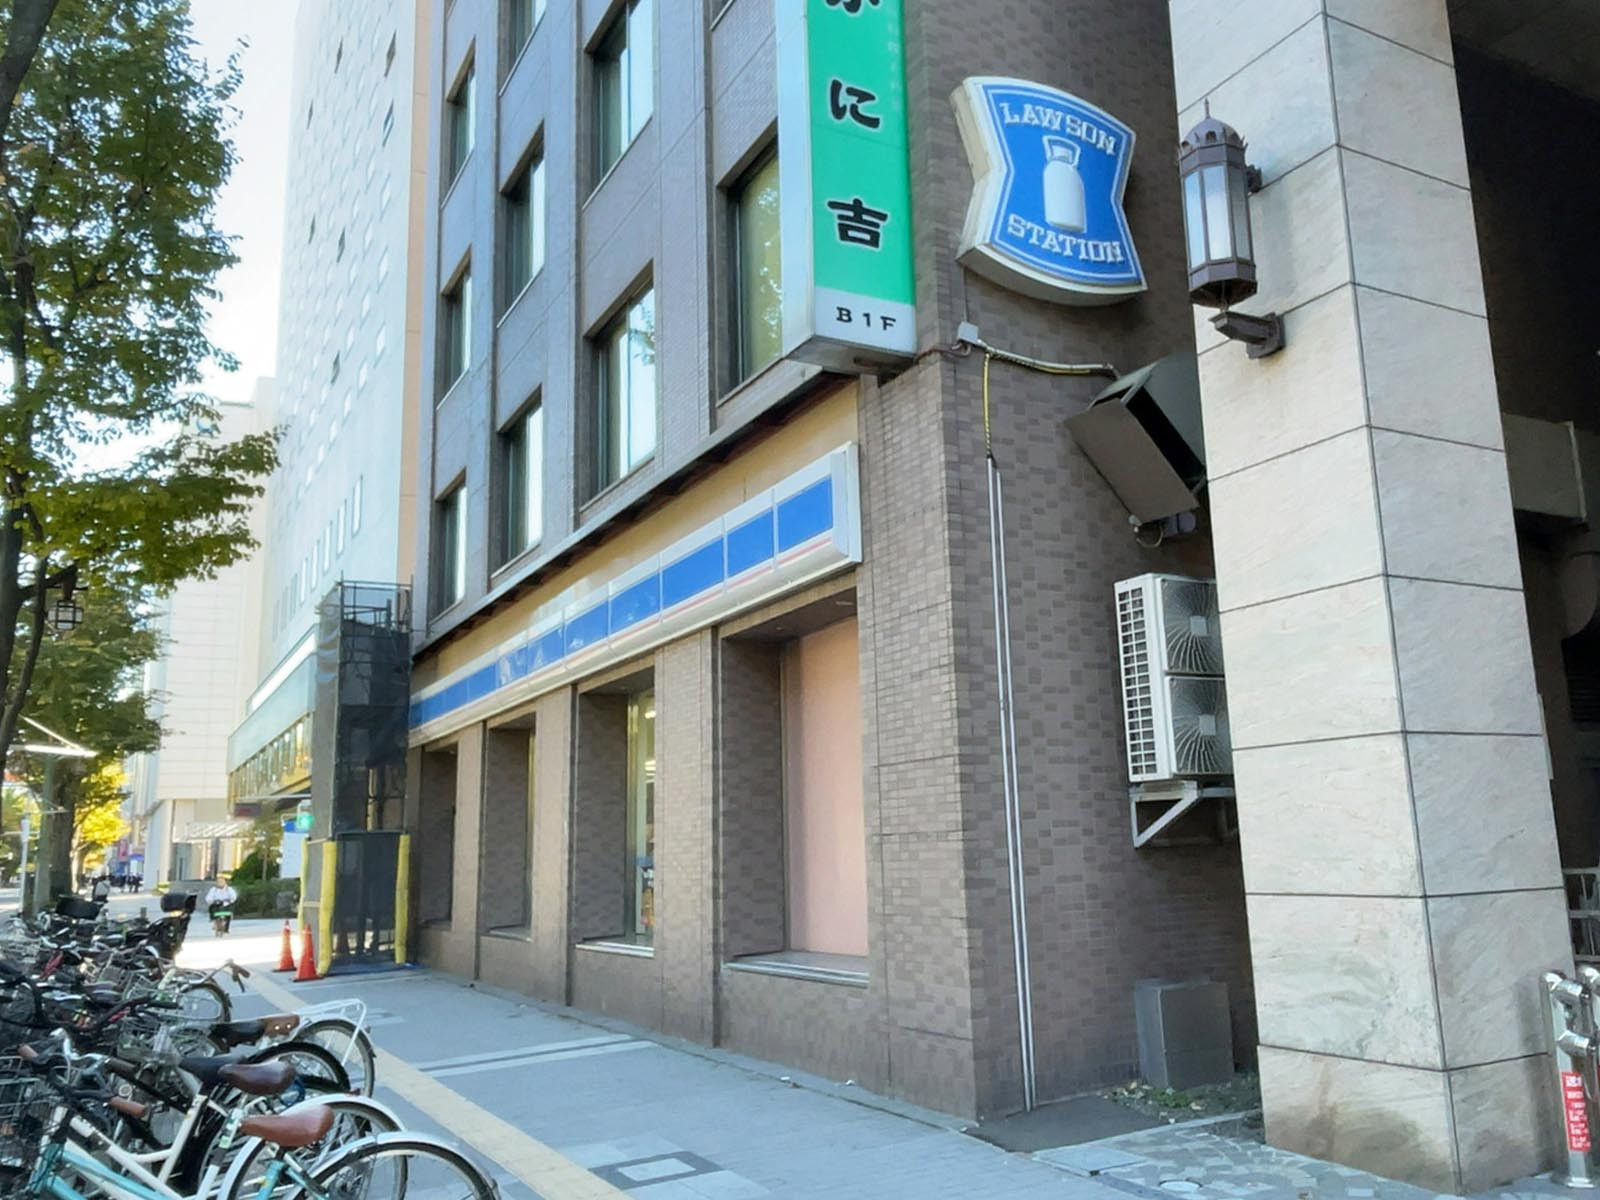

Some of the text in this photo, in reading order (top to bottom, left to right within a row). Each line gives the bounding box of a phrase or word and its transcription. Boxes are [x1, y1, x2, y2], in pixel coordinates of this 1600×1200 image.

[826, 0, 888, 249] に吉
[1000, 101, 1117, 156] LAWSON
[1006, 213, 1127, 264] STATION
[836, 306, 897, 331] B1F
